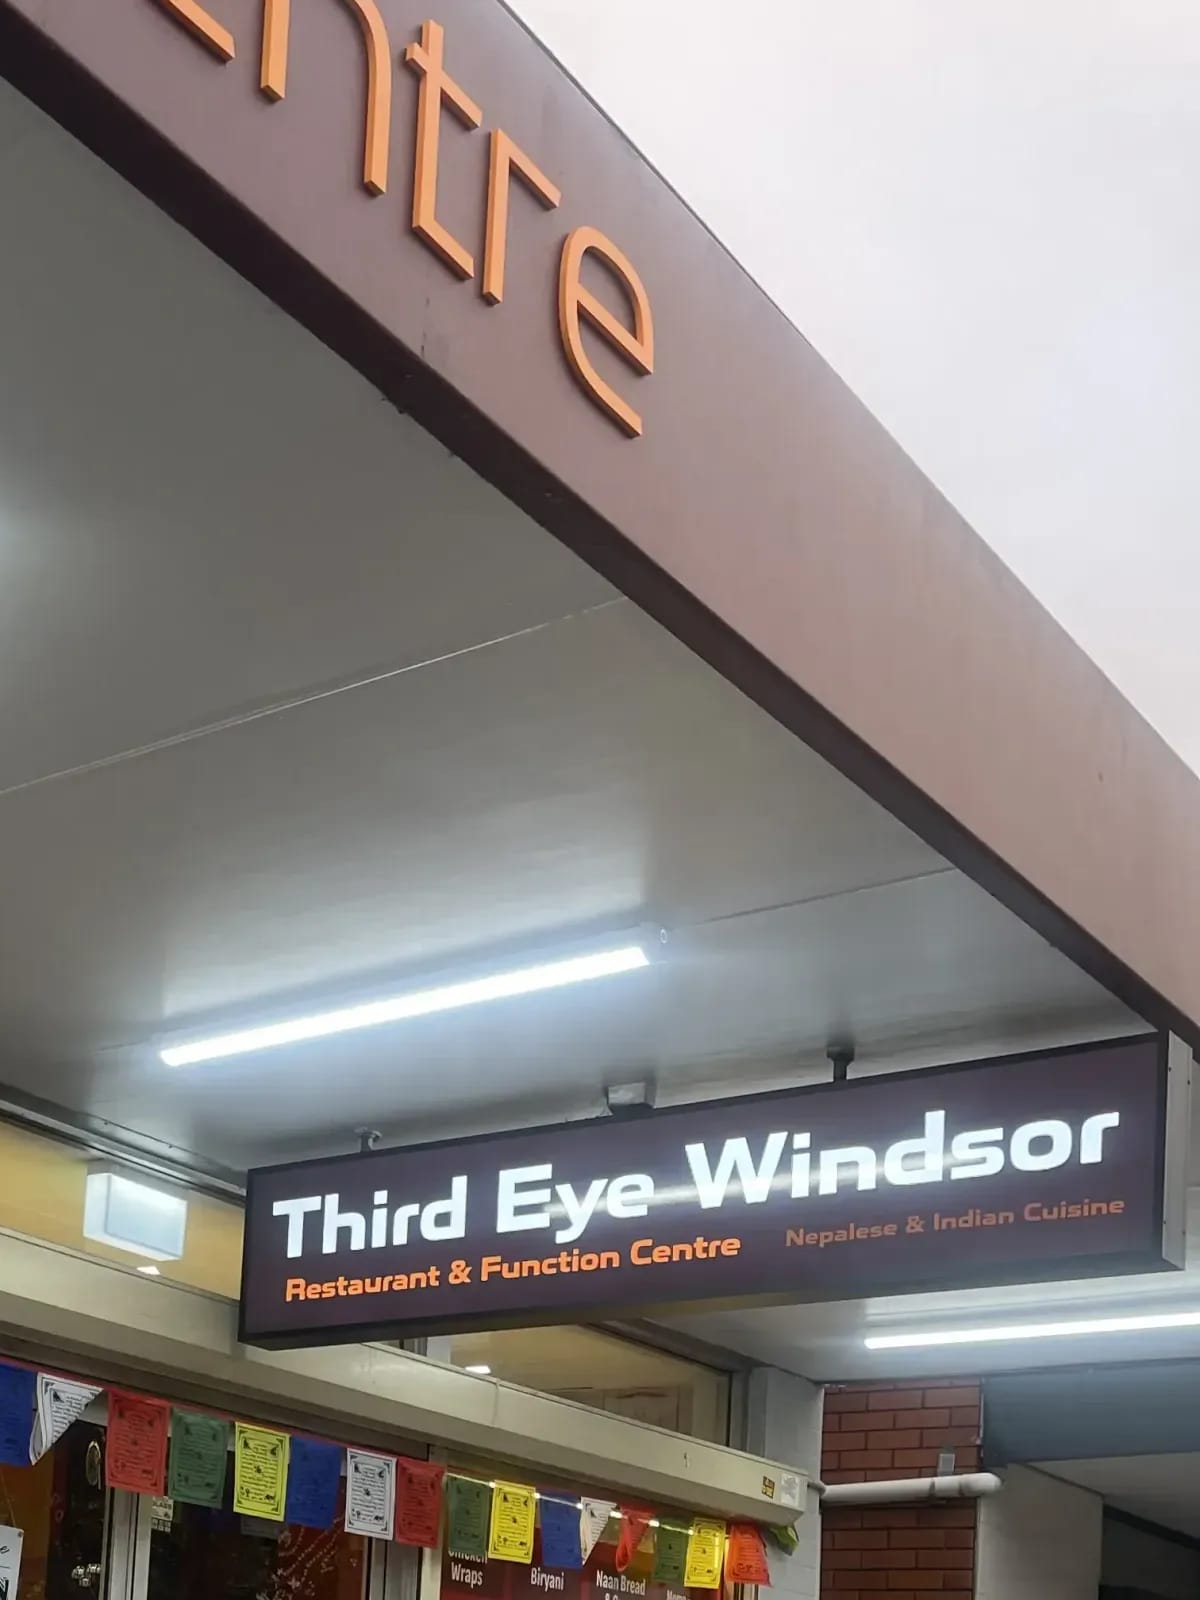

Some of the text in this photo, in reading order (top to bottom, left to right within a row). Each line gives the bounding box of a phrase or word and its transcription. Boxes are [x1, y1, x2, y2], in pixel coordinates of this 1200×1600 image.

[154, 0, 654, 439] ntre
[272, 1110, 1119, 1258] Third Eye Windsor
[785, 1198, 1125, 1248] Nepalese & Indian Cuisine
[285, 1237, 741, 1302] Restaurant & Function Centre
[451, 1562, 483, 1589] Wraps
[530, 1567, 565, 1592] Biryani
[596, 1570, 646, 1596] Naan Bread
